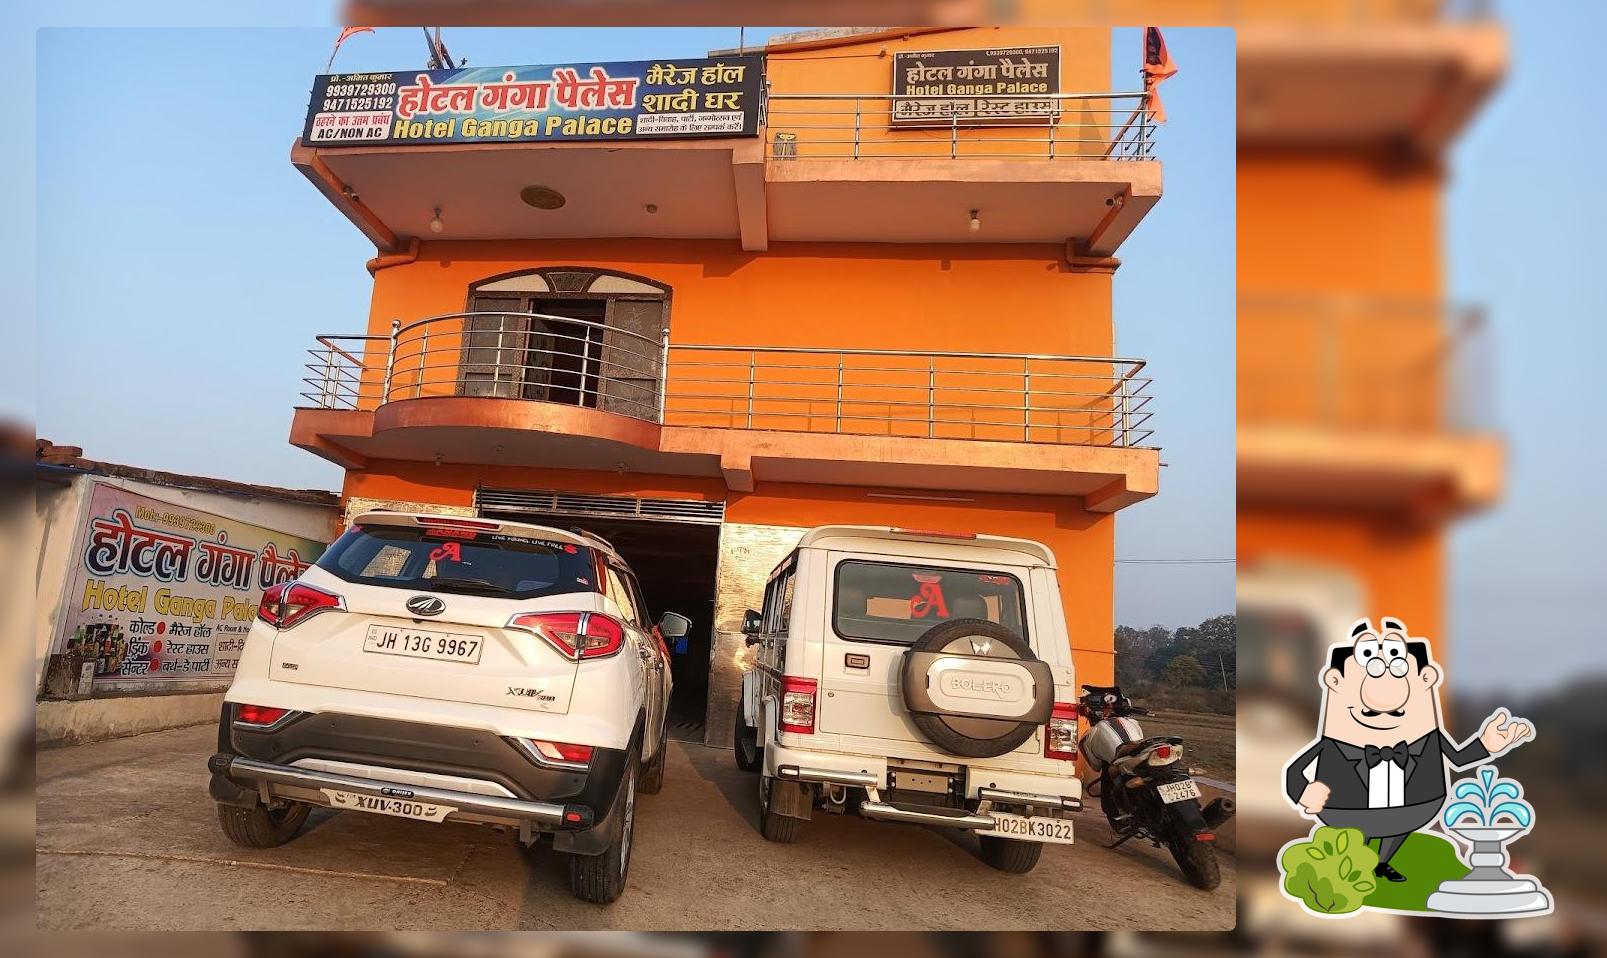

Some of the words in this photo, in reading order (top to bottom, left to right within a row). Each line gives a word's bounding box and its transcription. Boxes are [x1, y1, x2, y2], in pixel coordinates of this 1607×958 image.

[646, 63, 698, 86] मैरेज
[701, 63, 746, 86] हॉल
[906, 61, 954, 84] होटल
[957, 60, 997, 80] गंगा
[1000, 58, 1049, 79] पैलेस
[326, 82, 396, 97] 9939729300
[398, 74, 479, 118] होटल
[482, 74, 552, 111] गंगा
[554, 68, 638, 109] पैलेस
[906, 83, 943, 95] Hotel
[947, 83, 993, 95] Ganga
[997, 82, 1047, 94] Palace
[323, 97, 393, 111] 9471525192
[642, 88, 699, 112] शादी
[705, 92, 744, 110] घर
[339, 116, 349, 126] का
[393, 118, 456, 140] Hotel
[461, 118, 538, 139] Ganga
[545, 115, 632, 136] Palace
[317, 128, 364, 139] AC/NON
[366, 127, 382, 137] AC
[87, 511, 195, 581] होटल
[197, 531, 257, 589] गंगा
[81, 579, 149, 614] Hotel
[154, 587, 216, 623] Ganga
[130, 617, 157, 635] कोल्ड
[169, 622, 193, 637] मैरेज
[193, 624, 213, 638] हॉल
[128, 637, 149, 658] ड्रिंक
[167, 640, 186, 653] रेस्ट
[186, 644, 209, 655] हाउस
[377, 632, 398, 650] JH
[404, 634, 431, 653] 13G
[436, 638, 478, 657] 9967
[121, 658, 151, 676] सेन्टर
[191, 658, 212, 672] पार्टी
[951, 677, 1012, 699] BOLERO
[354, 796, 423, 816] XUV-300
